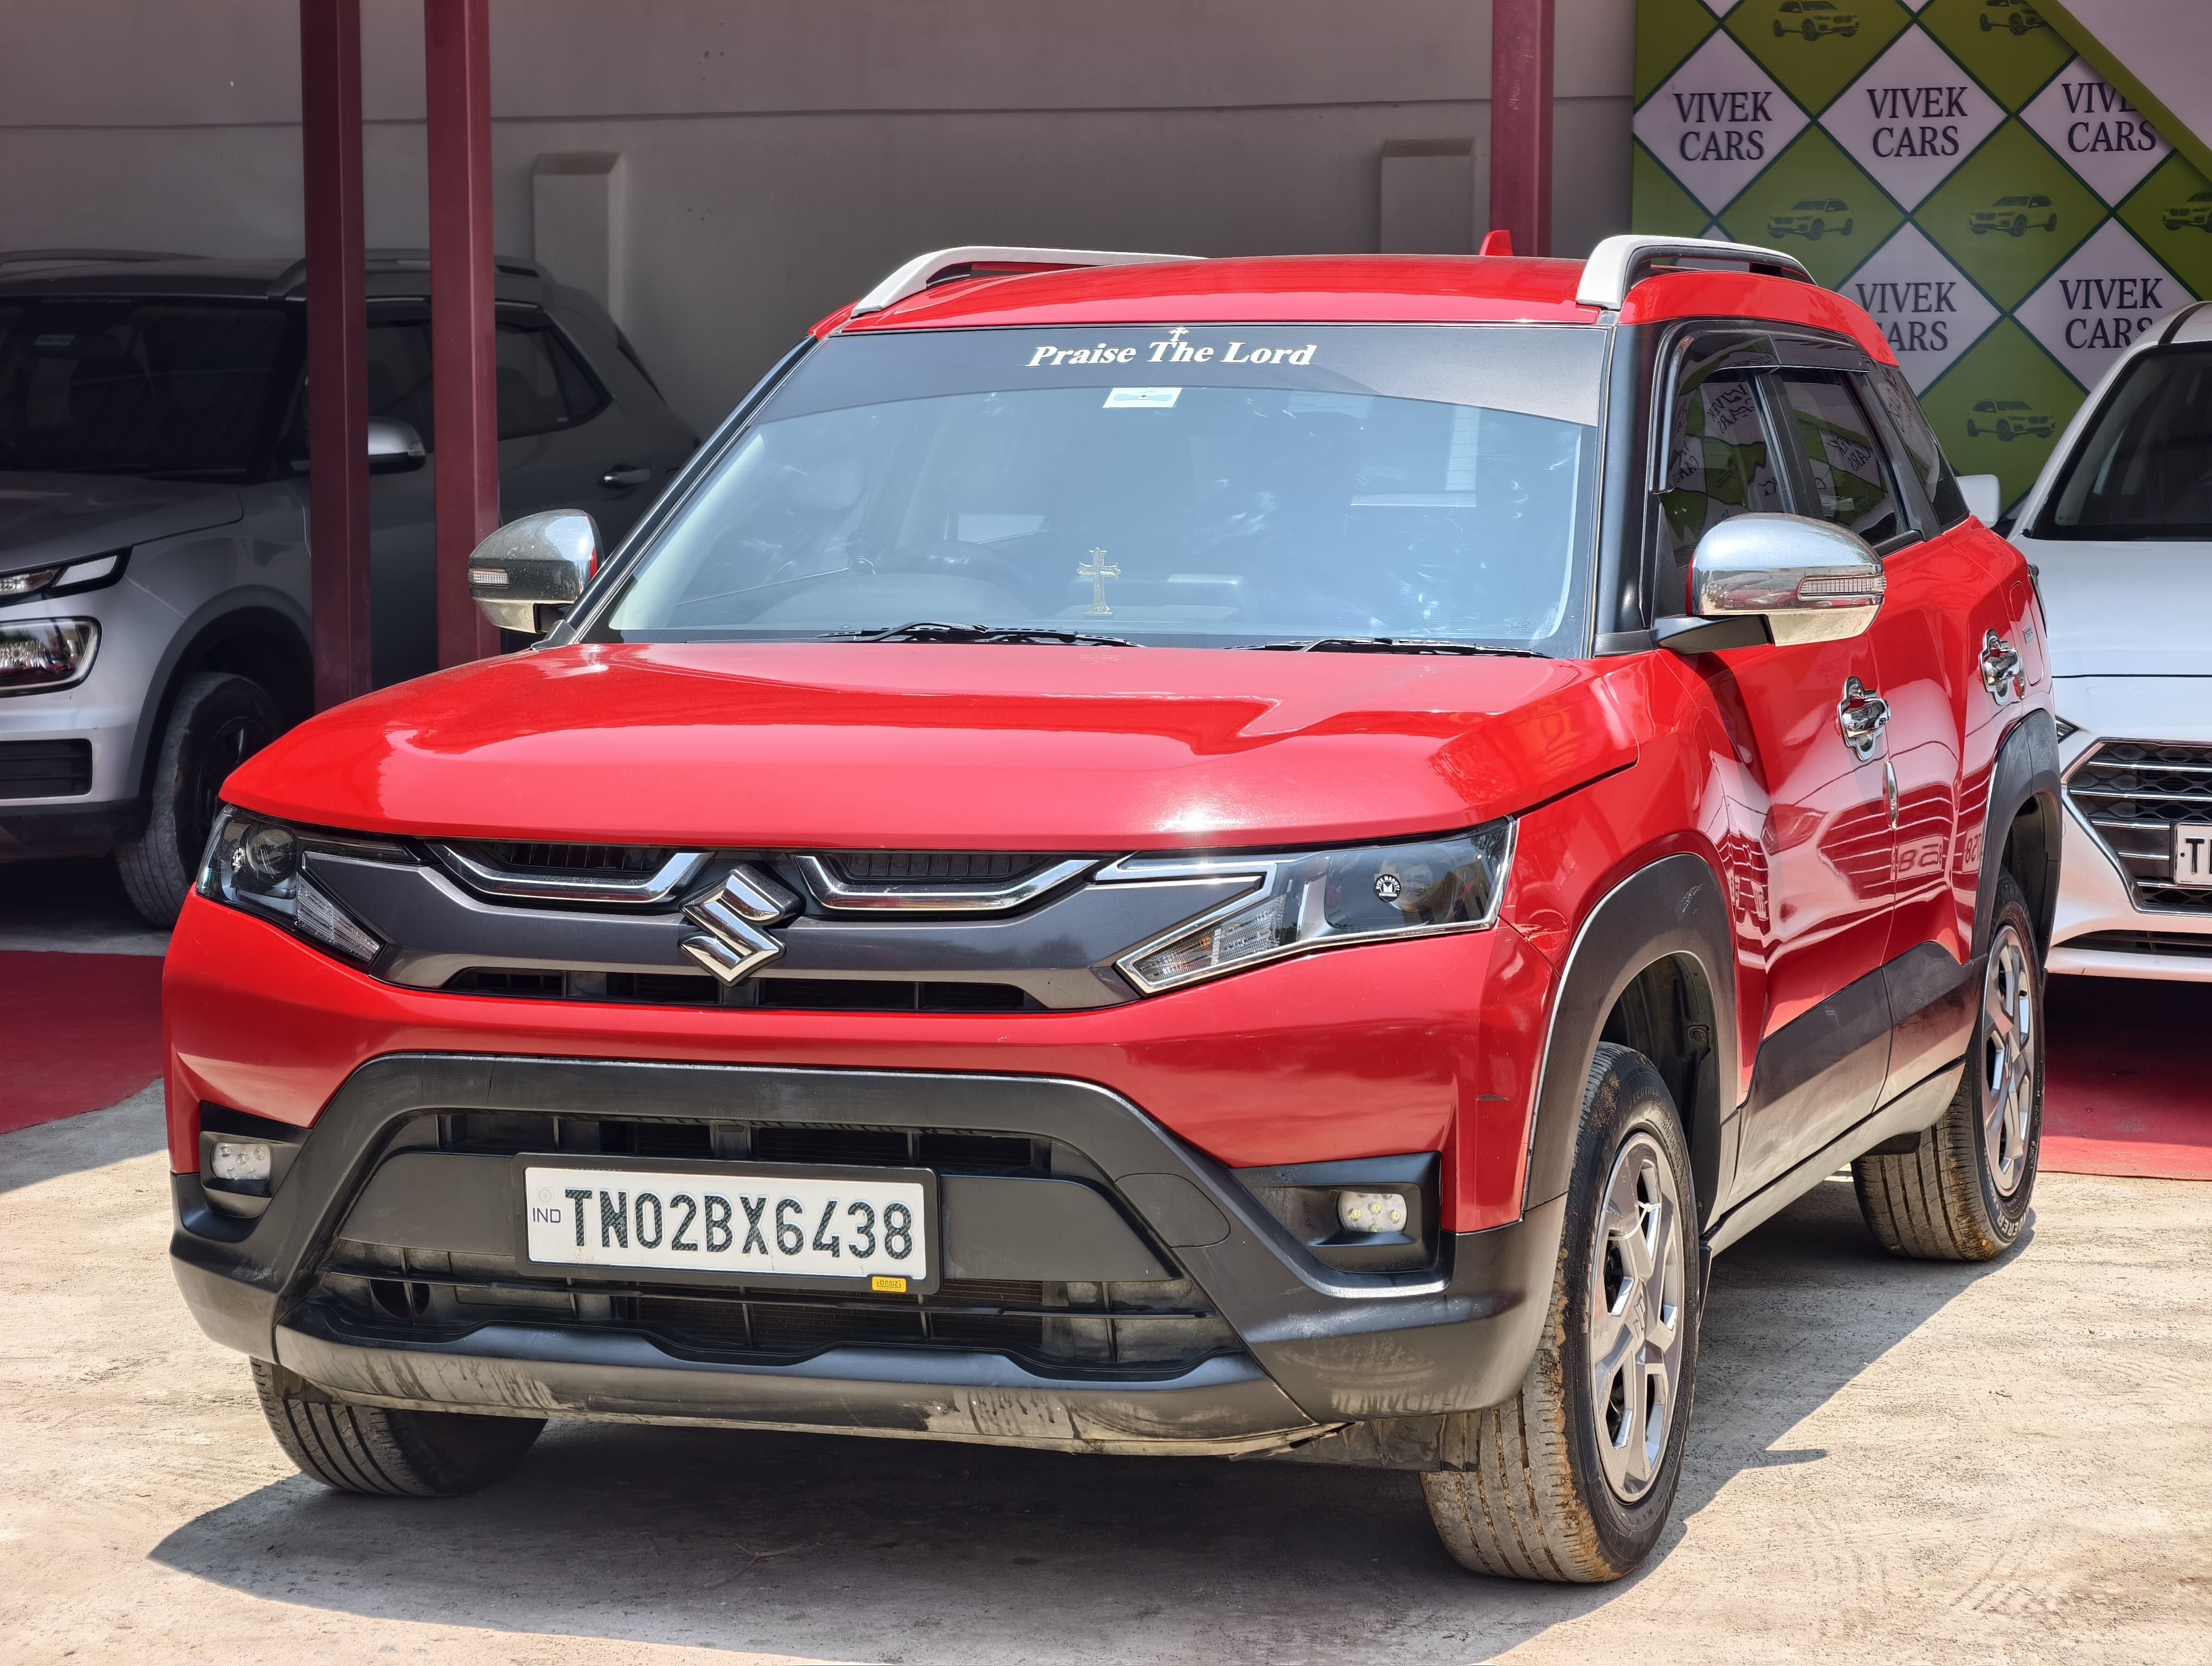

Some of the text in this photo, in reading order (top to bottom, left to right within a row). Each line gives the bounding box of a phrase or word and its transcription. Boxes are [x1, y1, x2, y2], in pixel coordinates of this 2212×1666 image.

[1674, 92, 1773, 123] VIVEK
[1866, 87, 1968, 119] VIVEK
[2061, 82, 2138, 113] VIV
[1680, 130, 1764, 161] CARS
[1873, 126, 1959, 158] CARS
[2068, 120, 2156, 152] CARS
[1855, 282, 1957, 313] VIVEK
[2059, 278, 2163, 310] VIVEK
[1876, 321, 1948, 351] ARS
[1025, 342, 1317, 367] Praise The Lord
[2185, 838, 2212, 875] T
[533, 1207, 561, 1223] IND
[565, 1189, 913, 1260] TN02BX6438
